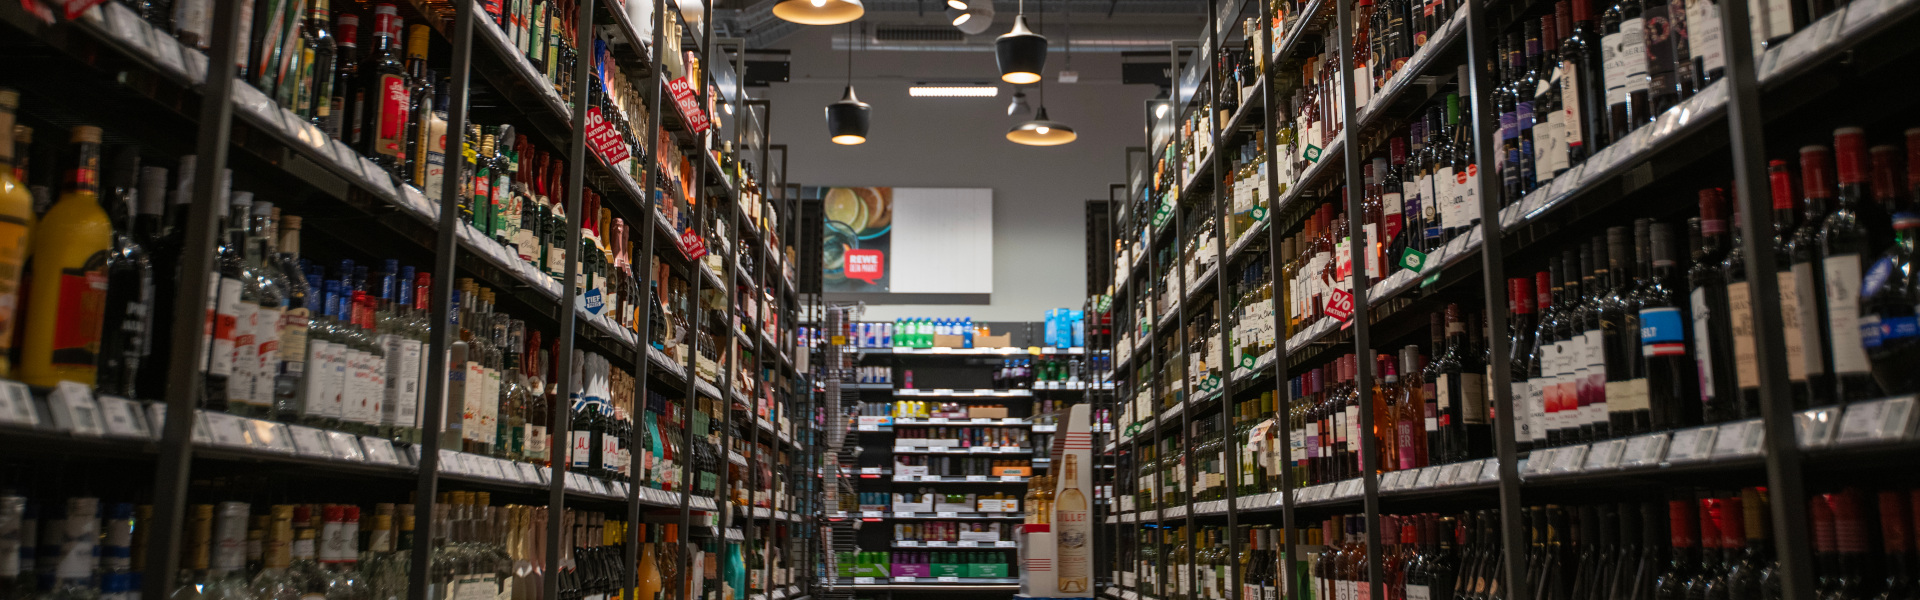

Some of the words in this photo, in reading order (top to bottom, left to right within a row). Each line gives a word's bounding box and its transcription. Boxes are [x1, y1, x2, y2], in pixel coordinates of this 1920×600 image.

[588, 124, 606, 138] AKTION
[600, 138, 618, 151] AKTION
[610, 150, 628, 163] AKTION
[849, 255, 879, 264] REWE
[586, 294, 600, 304] TIEF
[1326, 306, 1347, 319] AKTION
